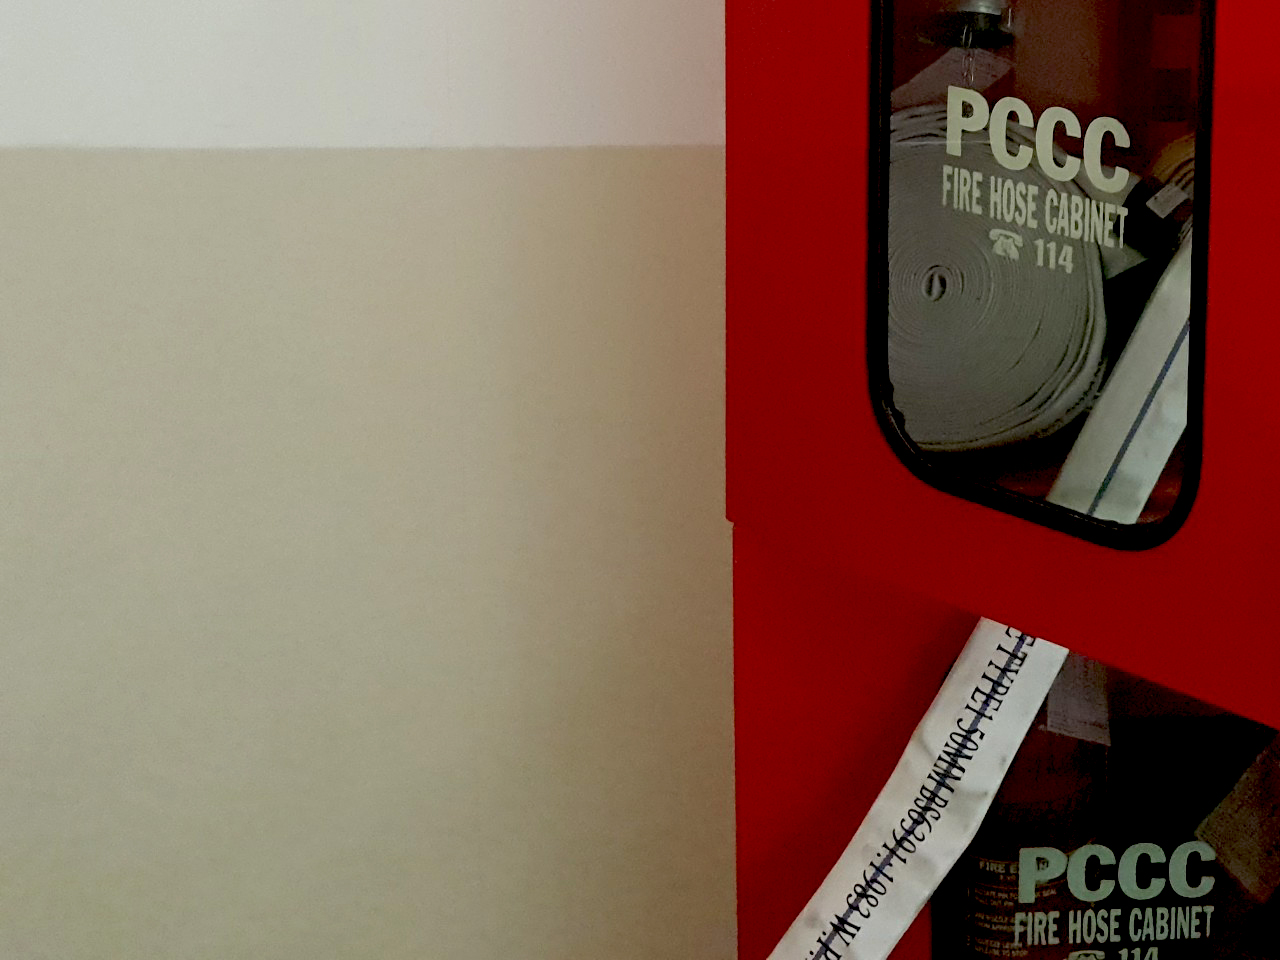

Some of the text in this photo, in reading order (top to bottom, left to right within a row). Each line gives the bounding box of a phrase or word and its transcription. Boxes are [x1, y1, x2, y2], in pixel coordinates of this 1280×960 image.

[946, 85, 1131, 193] PCCC
[942, 164, 1129, 249] FIRE HOSE CABINET
[1034, 238, 1074, 275] 114
[1018, 840, 1217, 904] PCCC
[1014, 910, 1061, 947] FIRE
[1068, 908, 1122, 944] HOSE
[1128, 905, 1215, 942] CABINET
